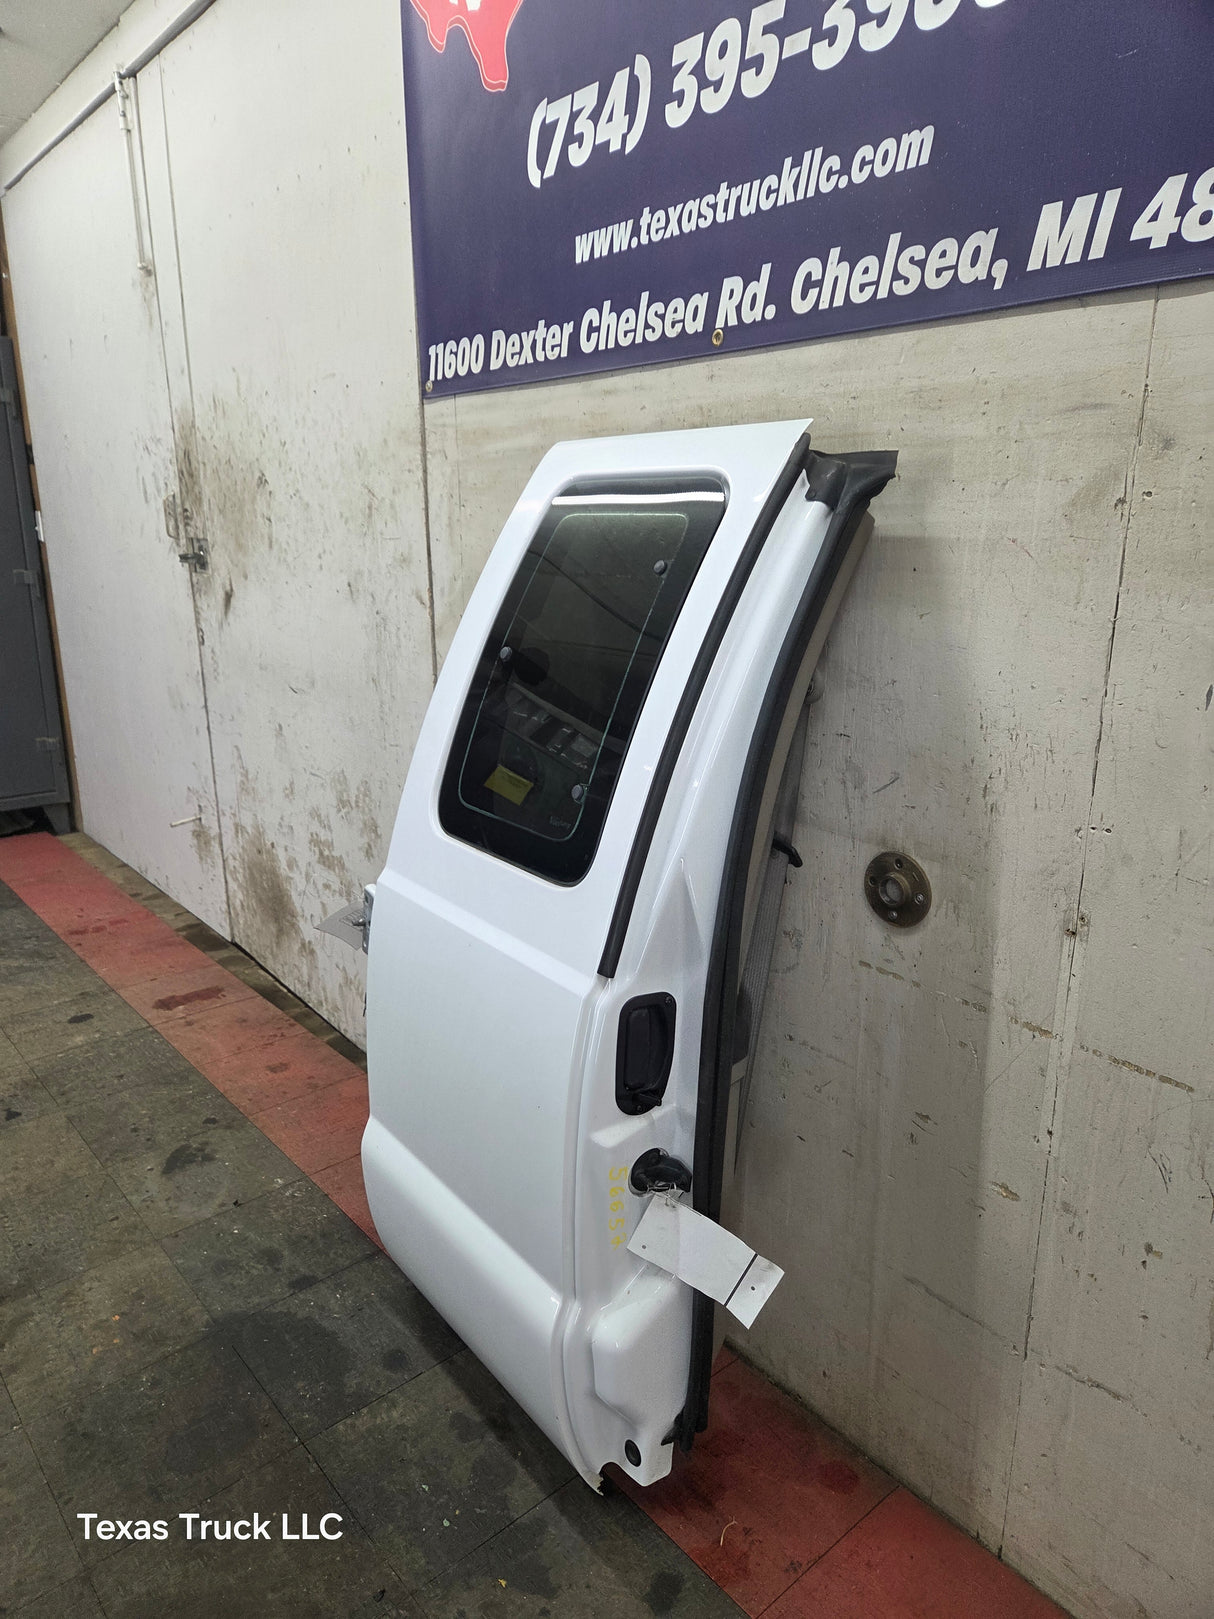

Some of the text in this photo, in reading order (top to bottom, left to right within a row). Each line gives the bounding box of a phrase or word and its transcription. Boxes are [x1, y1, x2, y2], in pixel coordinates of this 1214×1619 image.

[527, 0, 1005, 188] (734) 395-39
[428, 334, 485, 381] 11600
[490, 319, 574, 371] Dexter
[579, 291, 709, 354] Chelsea
[715, 263, 776, 329] Rd.
[790, 228, 1008, 315] Chelsea,
[1026, 187, 1123, 272] MI
[575, 125, 935, 264] www.texastruckllc.com
